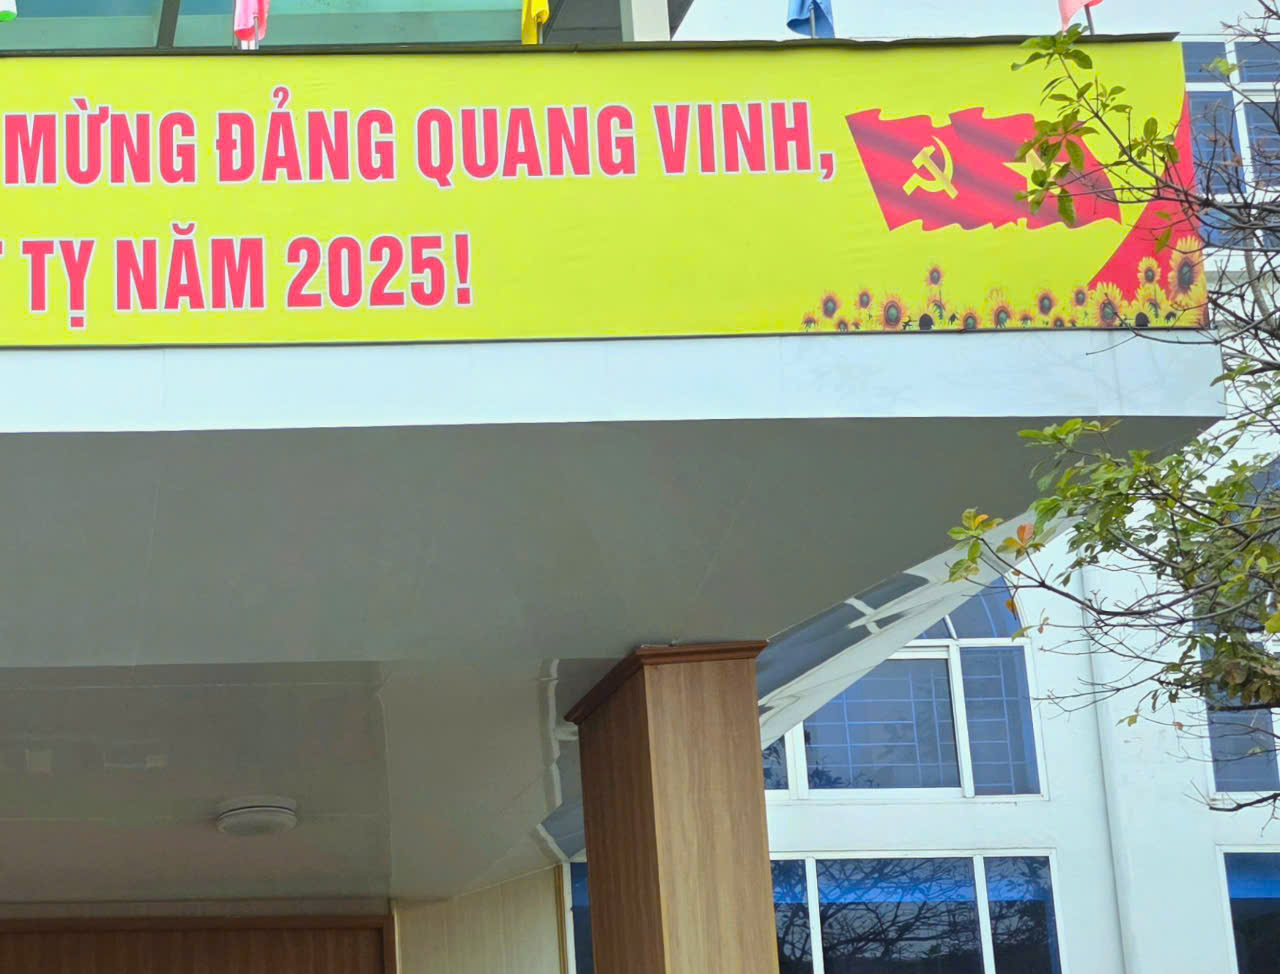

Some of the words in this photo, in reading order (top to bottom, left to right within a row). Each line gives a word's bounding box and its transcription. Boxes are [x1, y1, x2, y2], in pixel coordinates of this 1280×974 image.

[4, 98, 196, 185] MỪNG
[216, 86, 396, 182] ĐẢNG
[416, 105, 636, 188] QUANG
[654, 102, 835, 180] VINH,
[22, 239, 96, 329] TỴ
[115, 224, 266, 311] NĂM
[286, 233, 472, 309] 2025!
